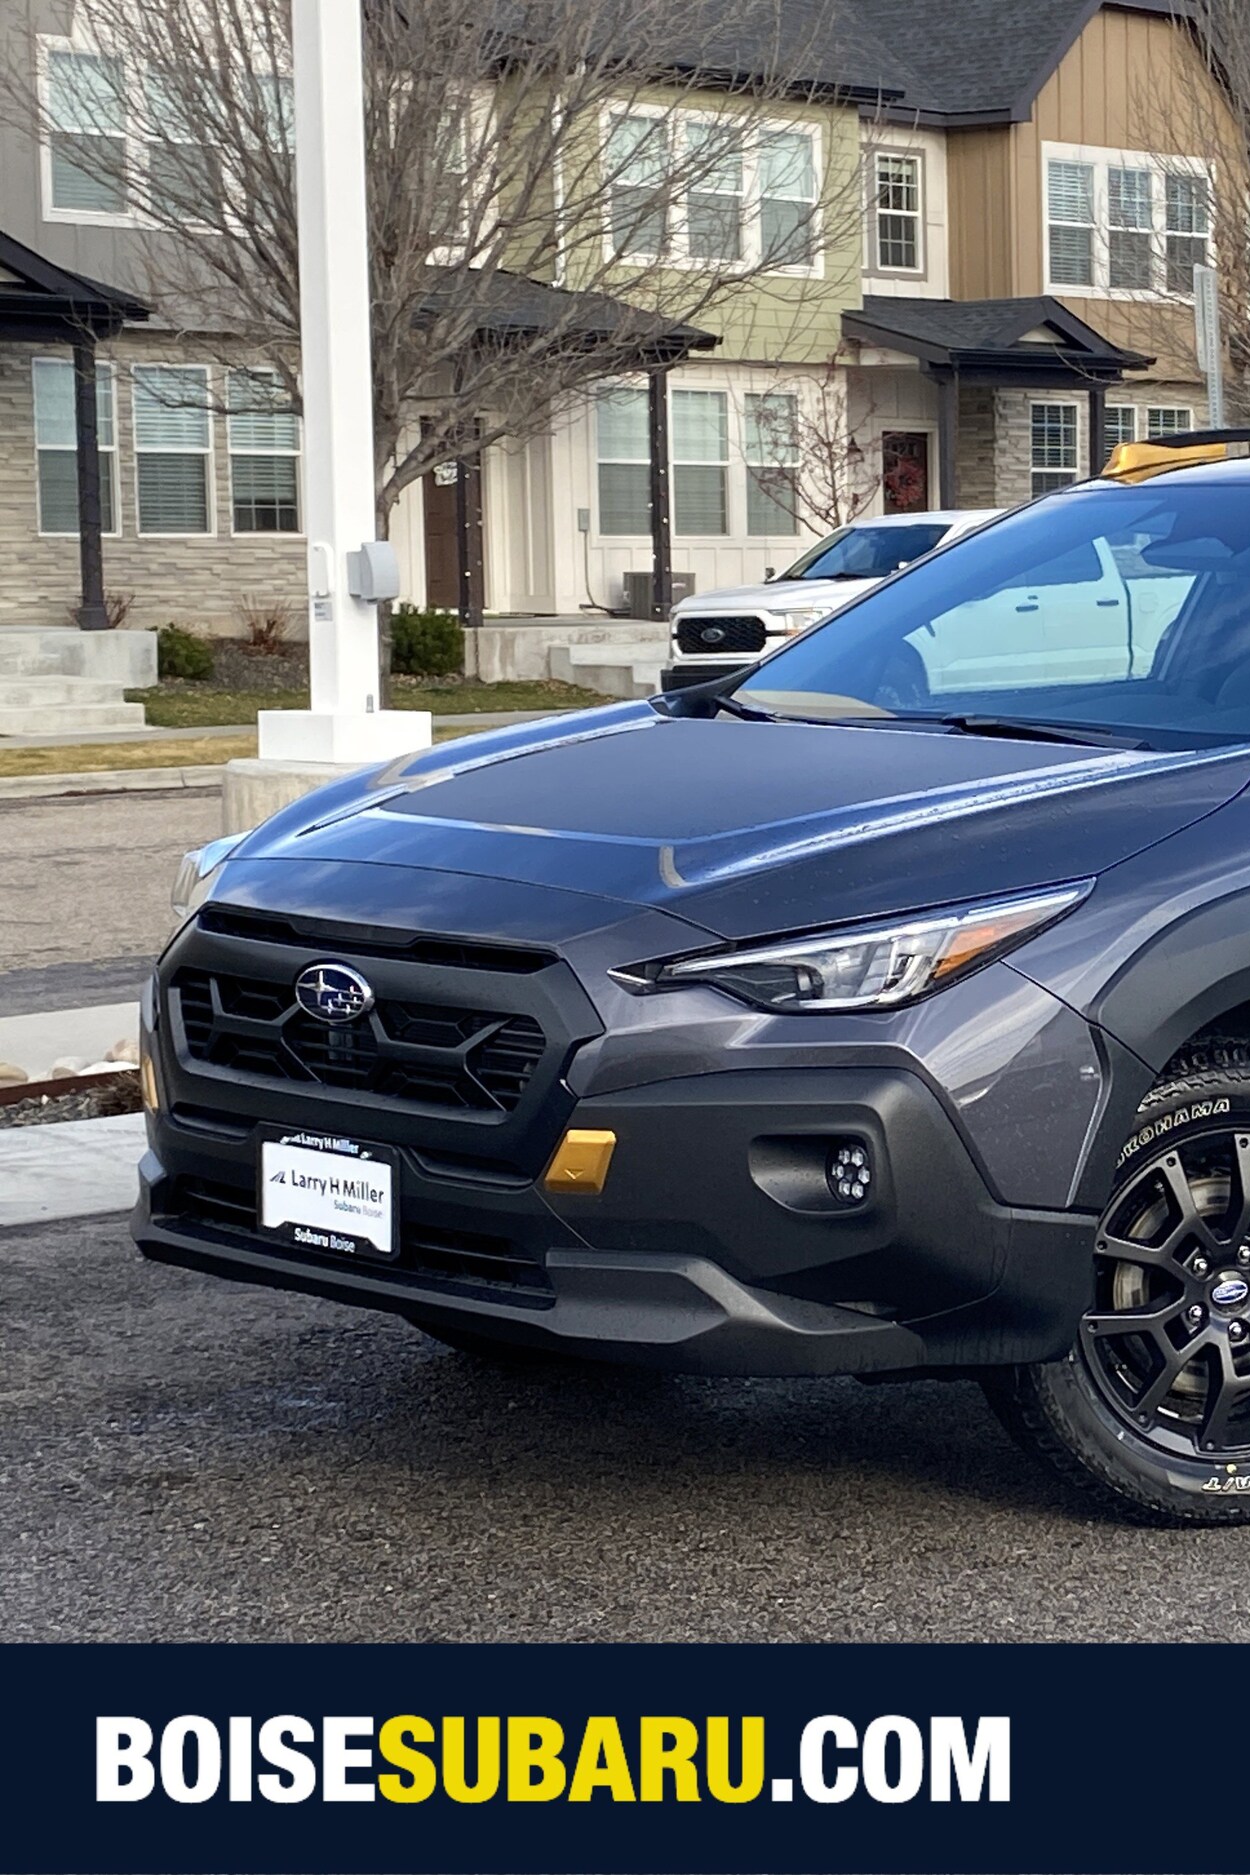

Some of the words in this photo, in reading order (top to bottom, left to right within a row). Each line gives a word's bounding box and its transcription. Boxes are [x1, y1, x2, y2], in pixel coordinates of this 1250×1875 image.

[301, 1132, 324, 1150] Larry
[1115, 1098, 1231, 1169] KOHAMA
[291, 1169, 327, 1196] Larry
[329, 1177, 340, 1195] H
[343, 1179, 385, 1204] Miller
[333, 1199, 362, 1215] Subaru
[294, 1227, 329, 1247] Subaru
[329, 1234, 356, 1253] Boise
